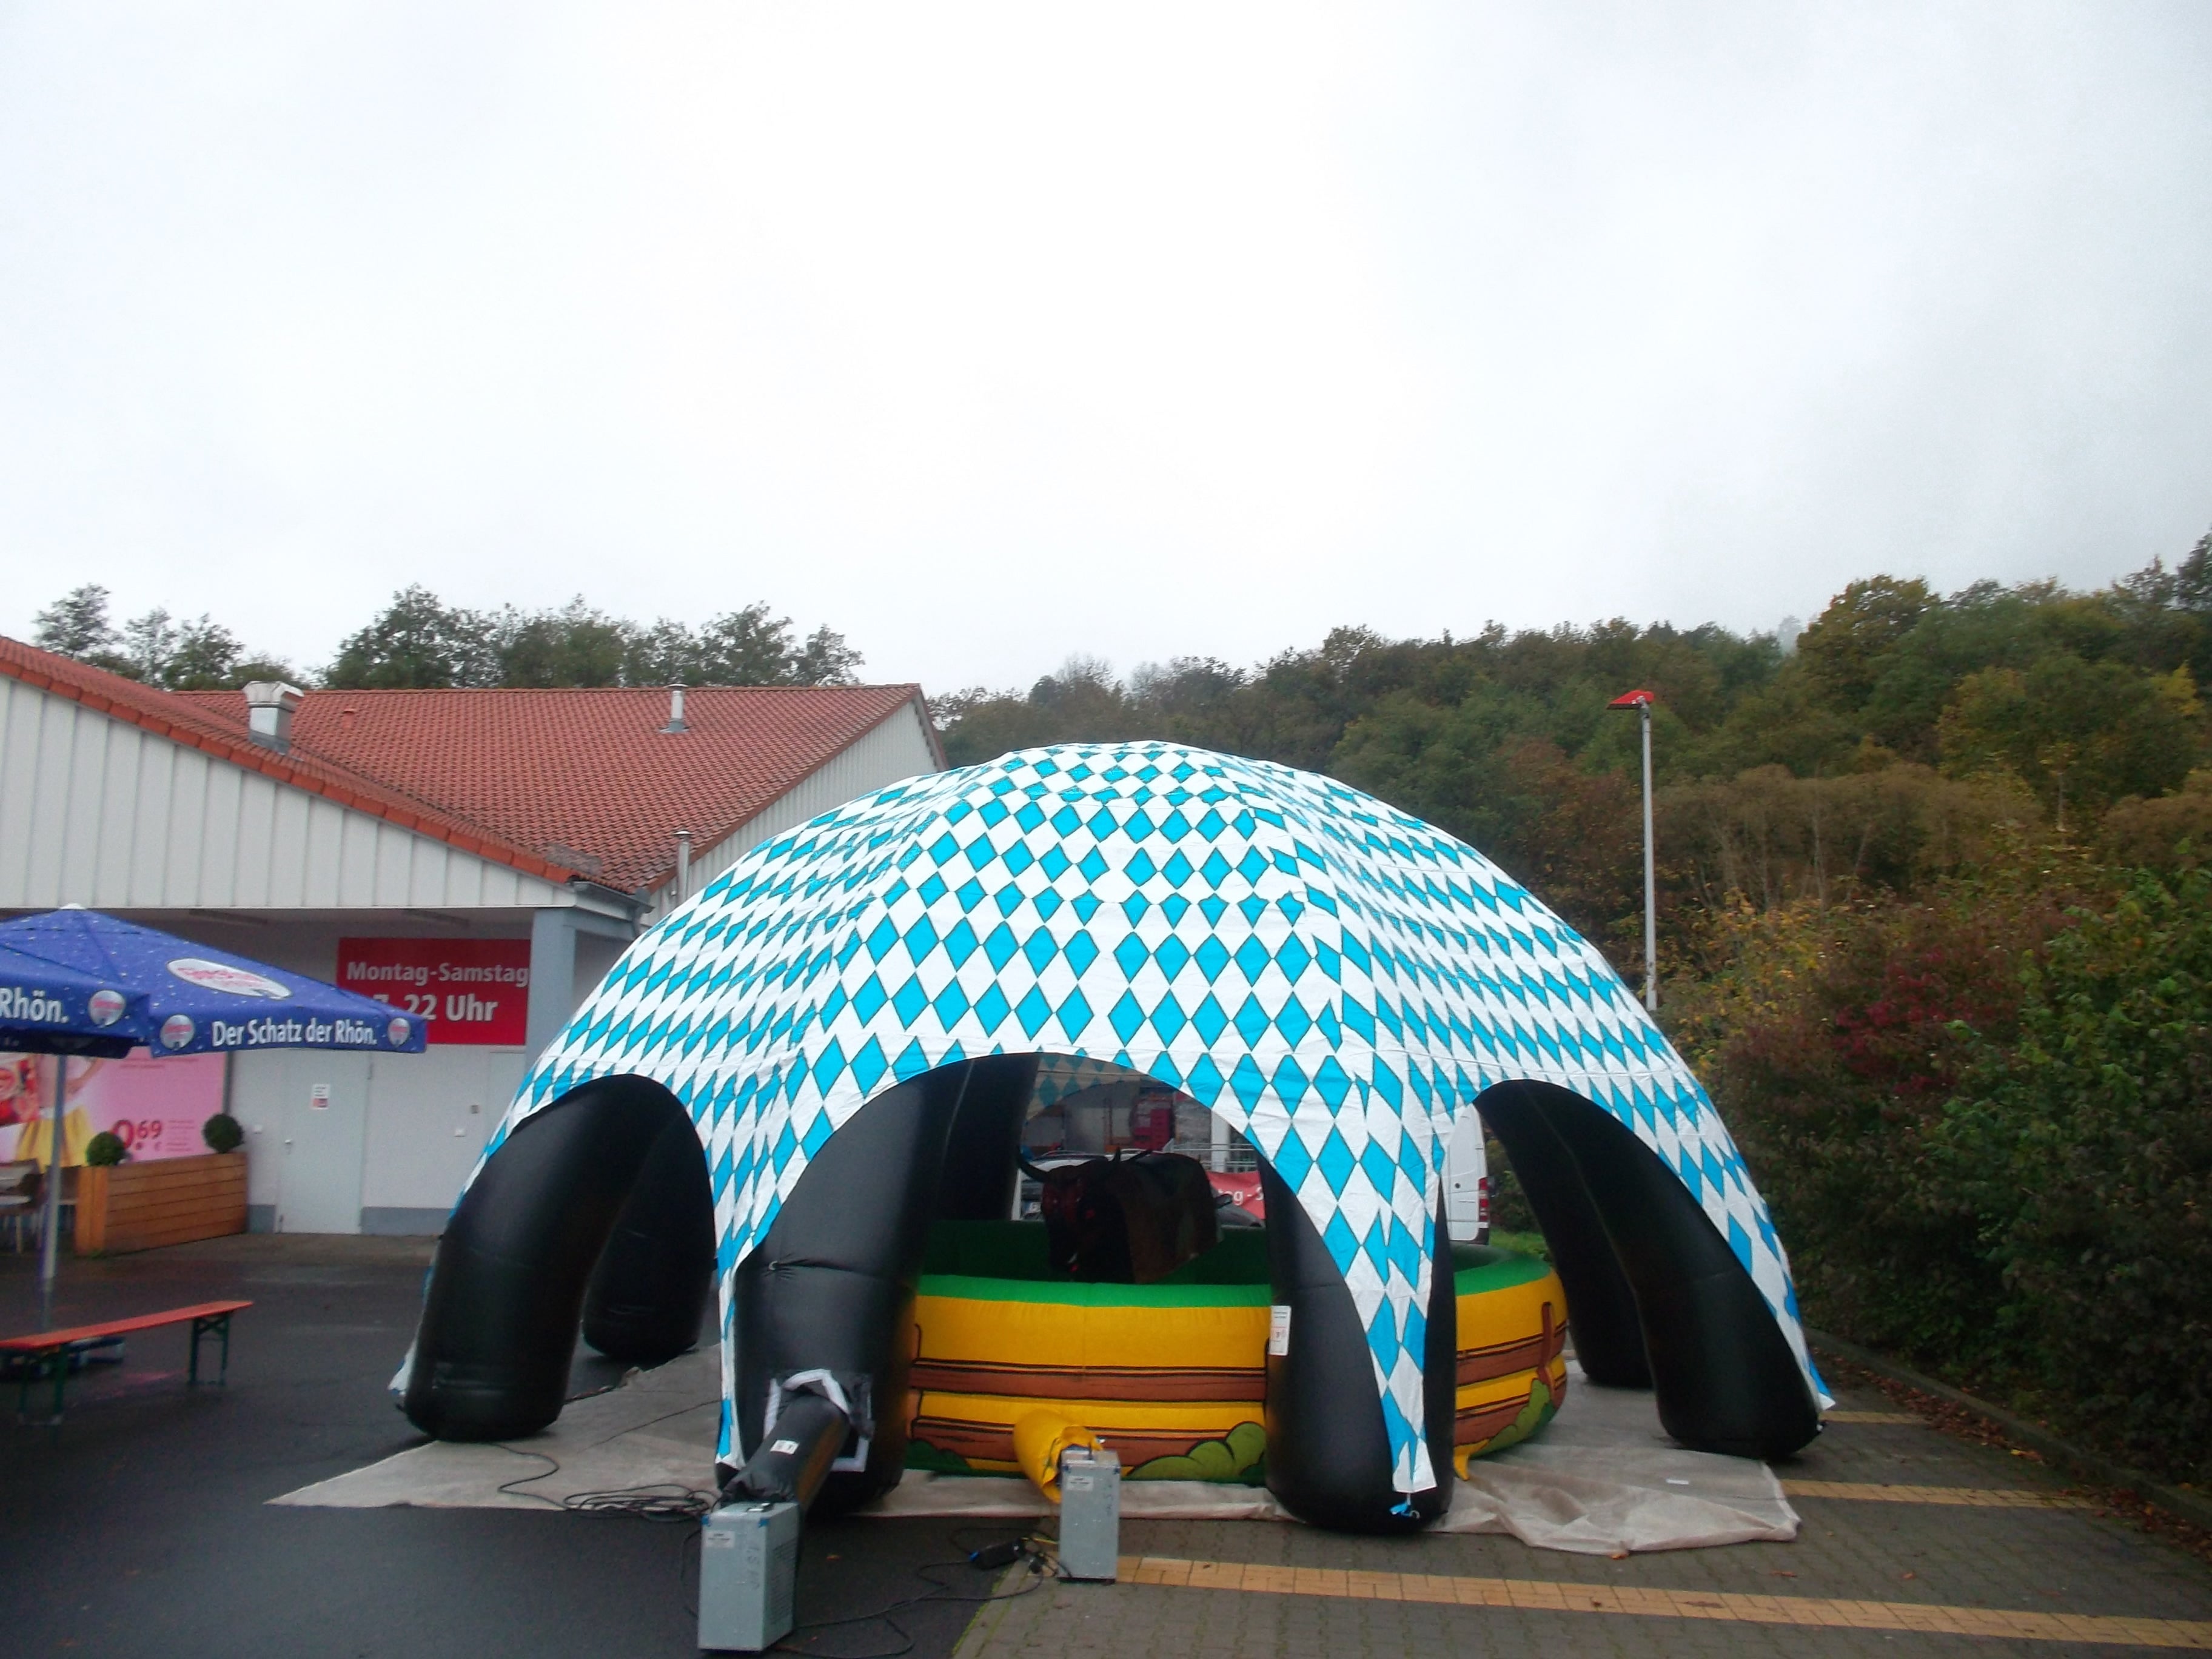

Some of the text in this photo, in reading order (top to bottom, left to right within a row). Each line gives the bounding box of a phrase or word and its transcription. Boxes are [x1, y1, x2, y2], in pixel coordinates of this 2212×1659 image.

[346, 962, 529, 987] Montag-Samstag
[446, 993, 498, 1021] Uhr
[212, 1021, 244, 1047] Der
[247, 1017, 302, 1045] Schatz
[305, 1017, 333, 1043] der
[335, 1019, 378, 1045] Rhön.
